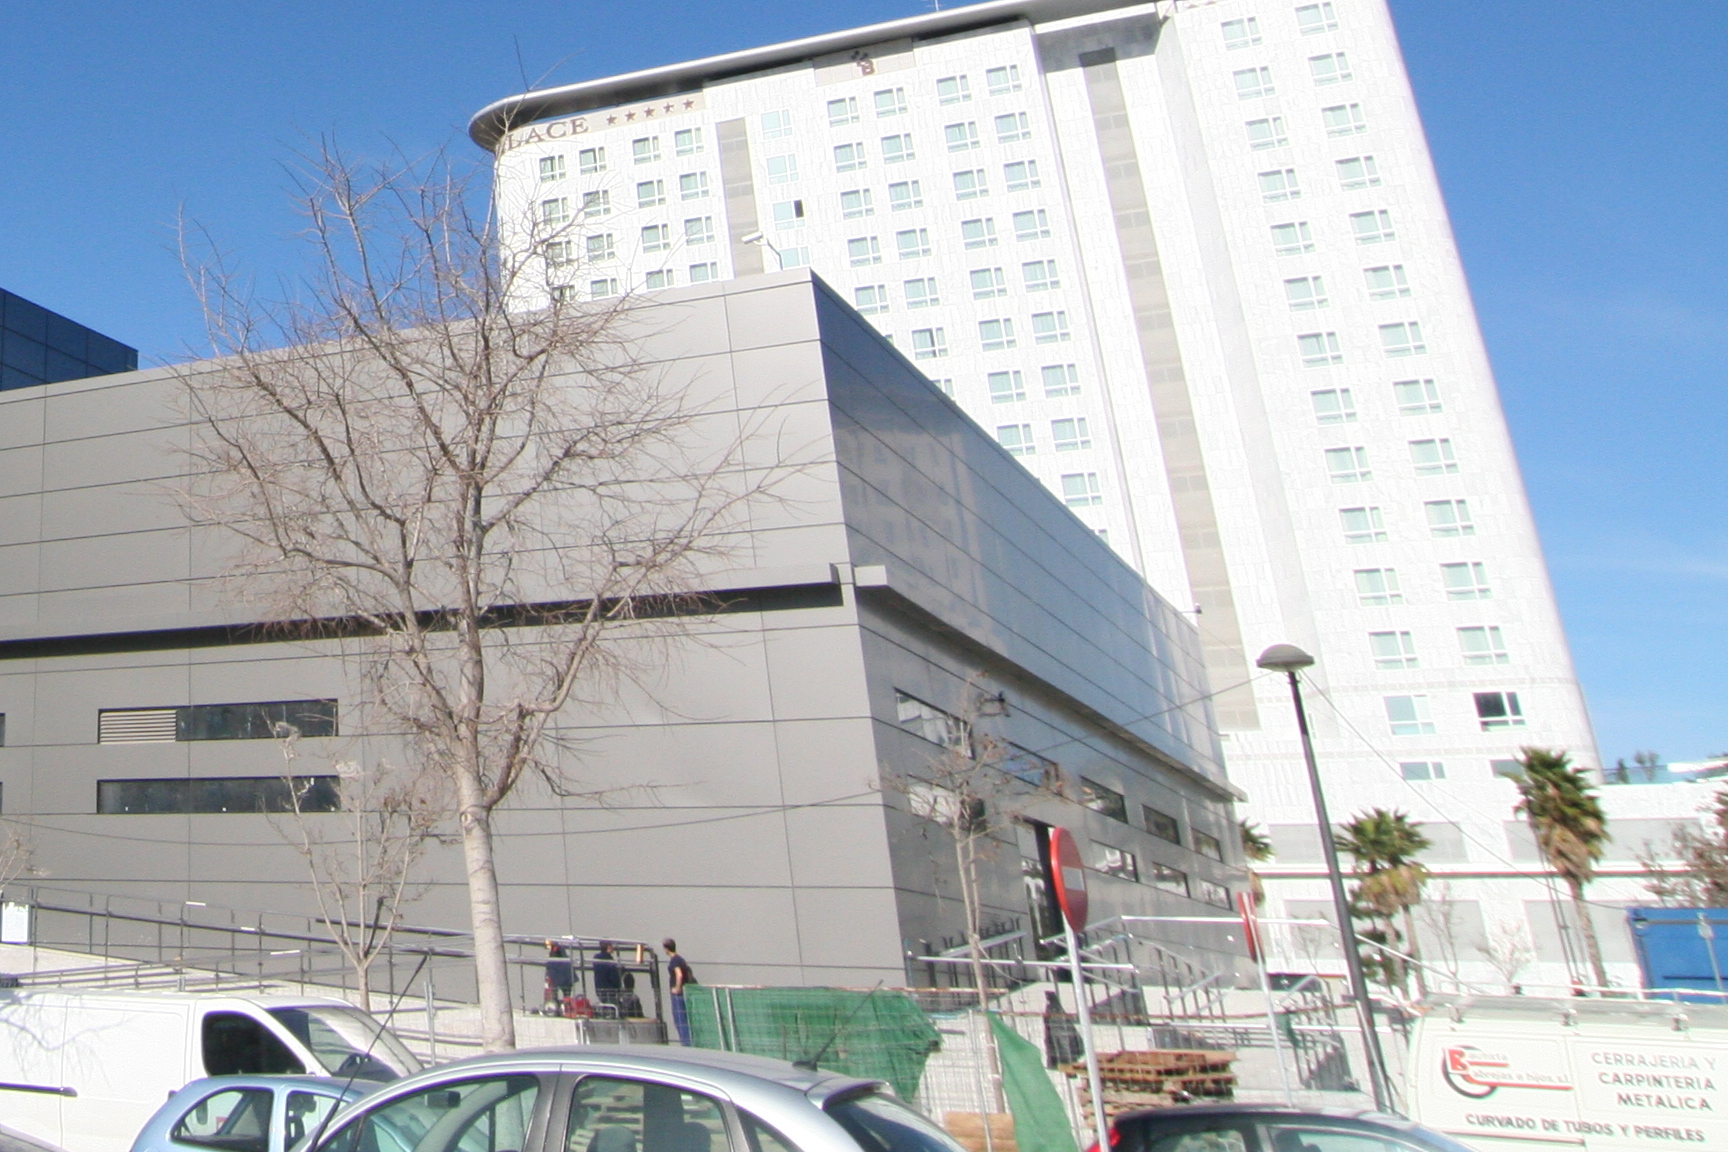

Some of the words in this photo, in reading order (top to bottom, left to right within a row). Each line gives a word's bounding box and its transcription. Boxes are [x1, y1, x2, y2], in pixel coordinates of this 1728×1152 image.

[1591, 1051, 1699, 1070] CERRAJERIA
[1704, 1056, 1717, 1071] Y
[1598, 1071, 1717, 1092] CARPINTERIA
[1616, 1092, 1713, 1112] METALICA
[1465, 1113, 1536, 1130] CURVADO
[1541, 1117, 1561, 1132] DE
[1564, 1119, 1613, 1136] TUBOS
[1617, 1123, 1630, 1137] Y
[1634, 1125, 1707, 1143] PERFILES
